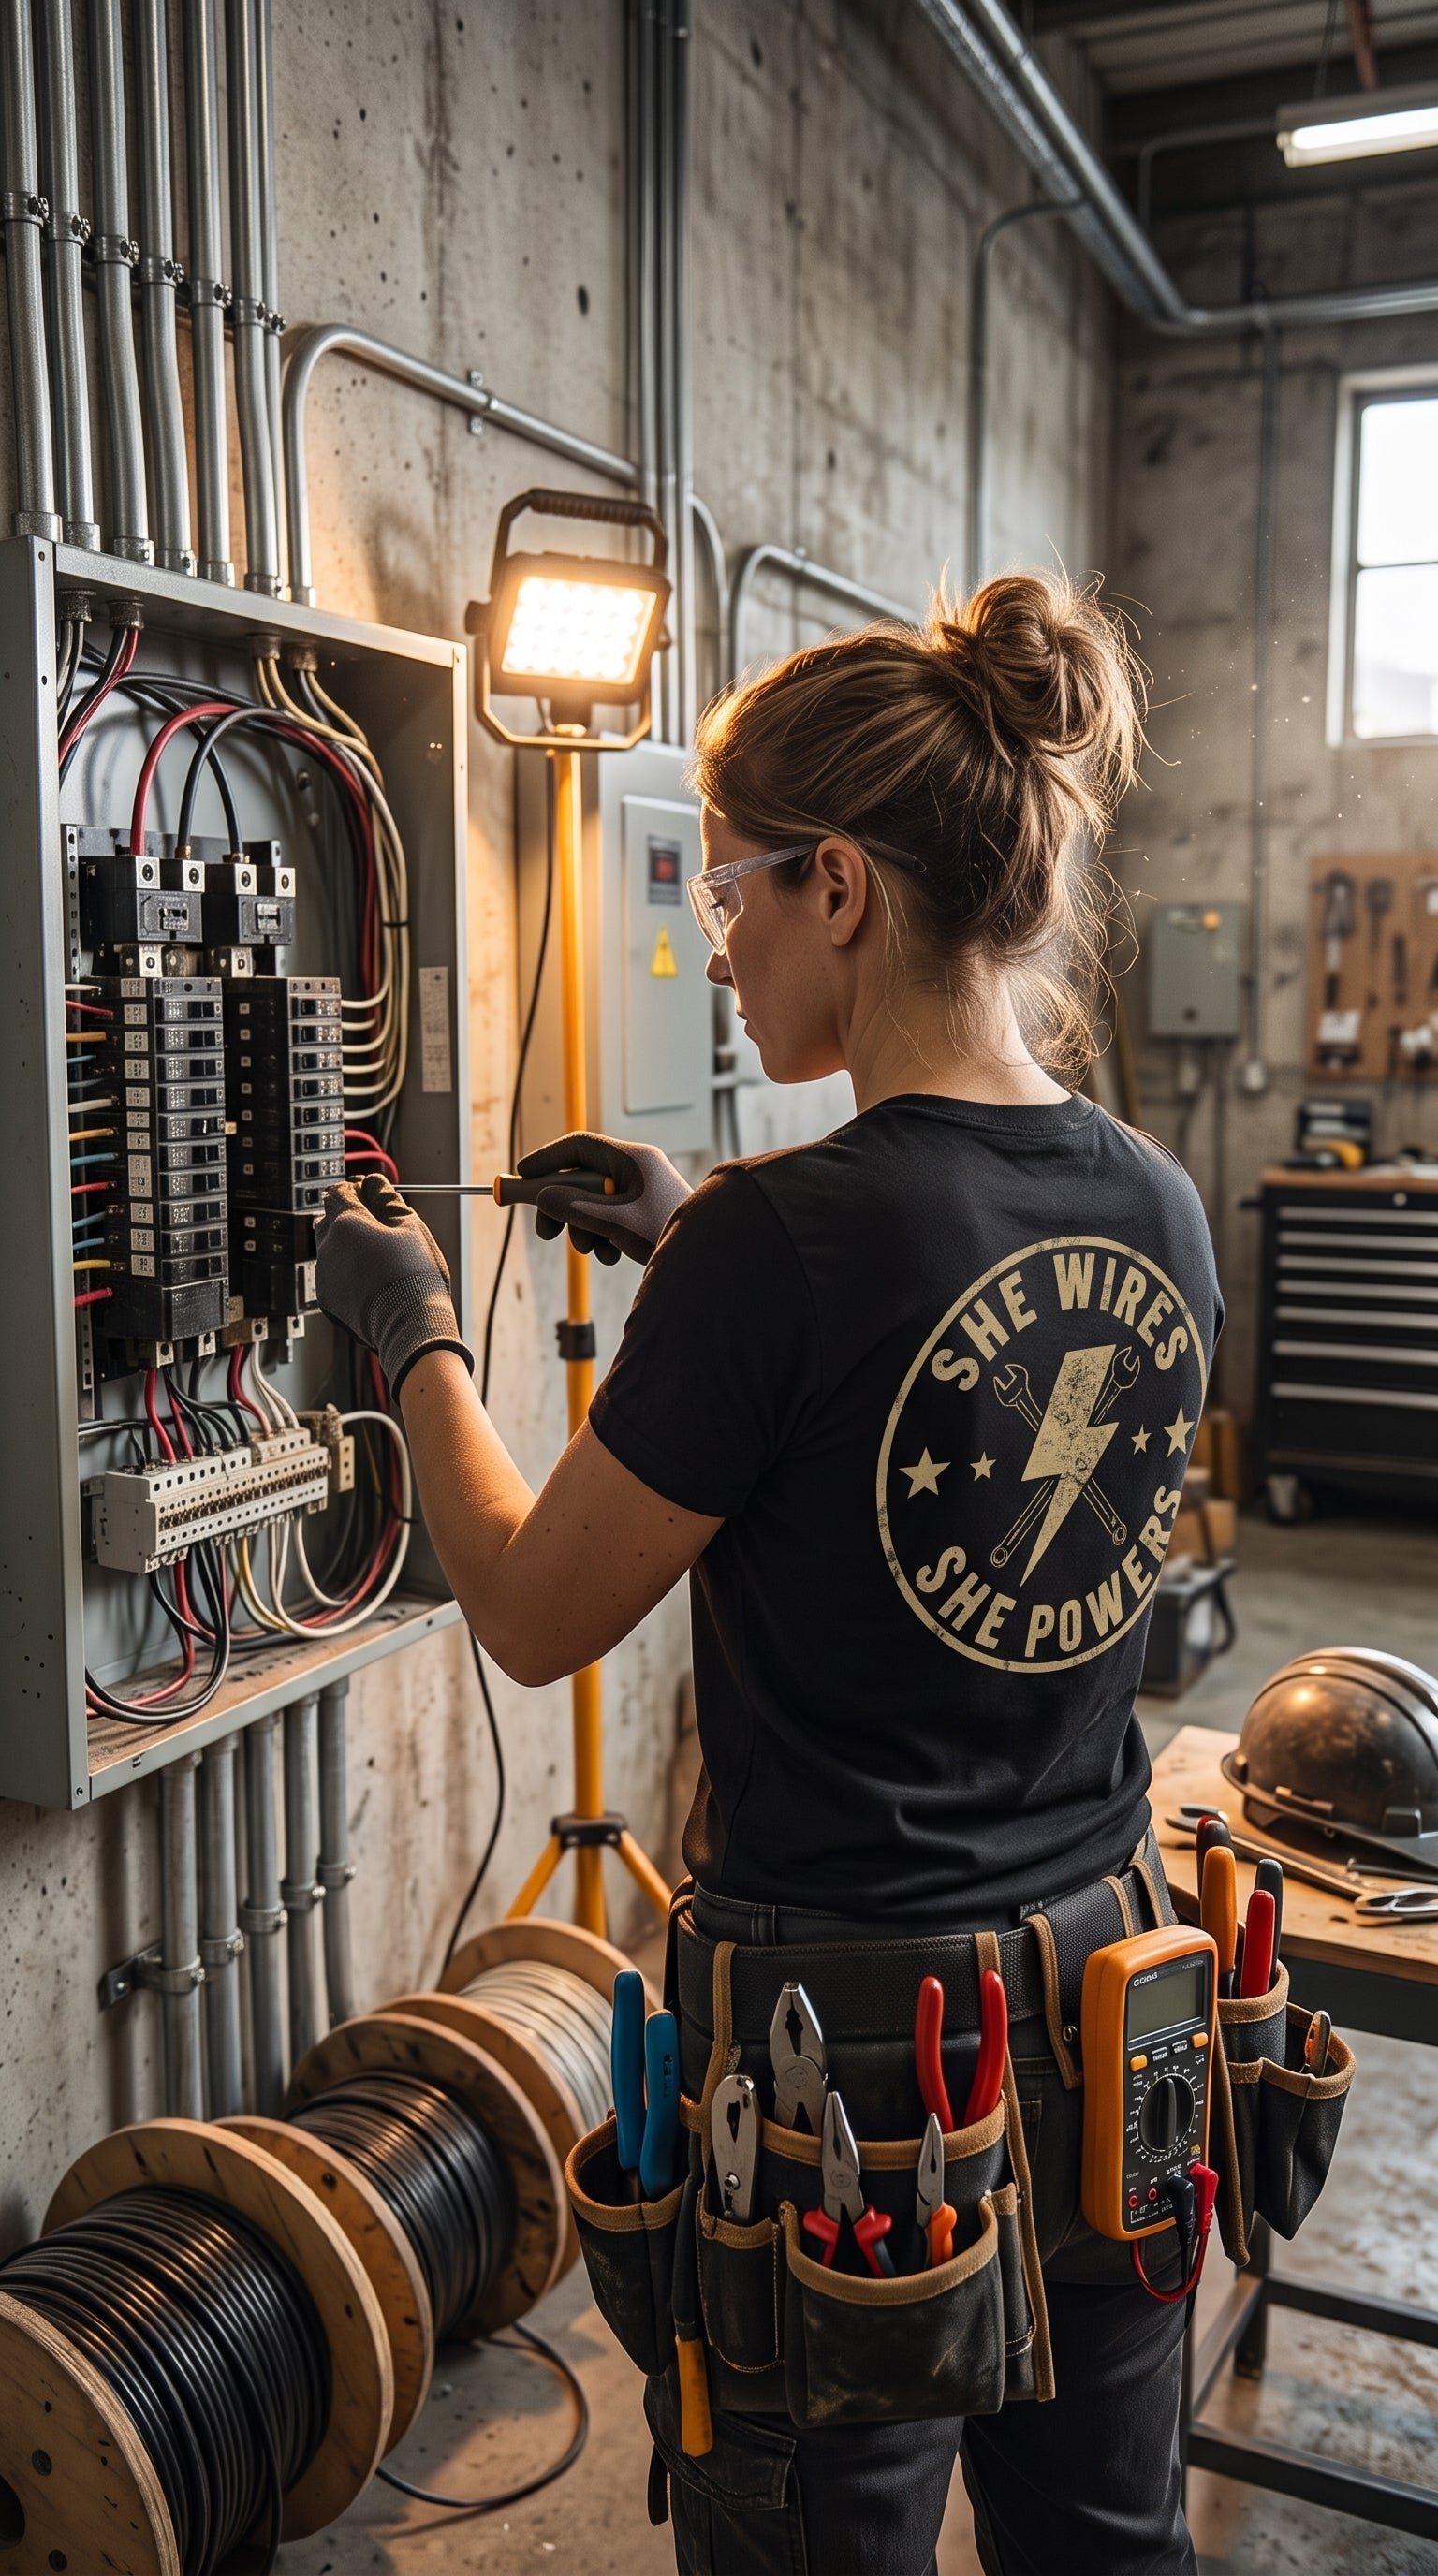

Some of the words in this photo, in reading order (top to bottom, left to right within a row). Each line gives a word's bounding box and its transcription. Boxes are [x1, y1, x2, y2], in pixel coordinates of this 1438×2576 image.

[932, 1270, 1037, 1391] SHE
[1053, 1253, 1188, 1371] WIRES
[916, 1546, 1016, 1649] SHE
[1024, 1486, 1181, 1658] POWERS
